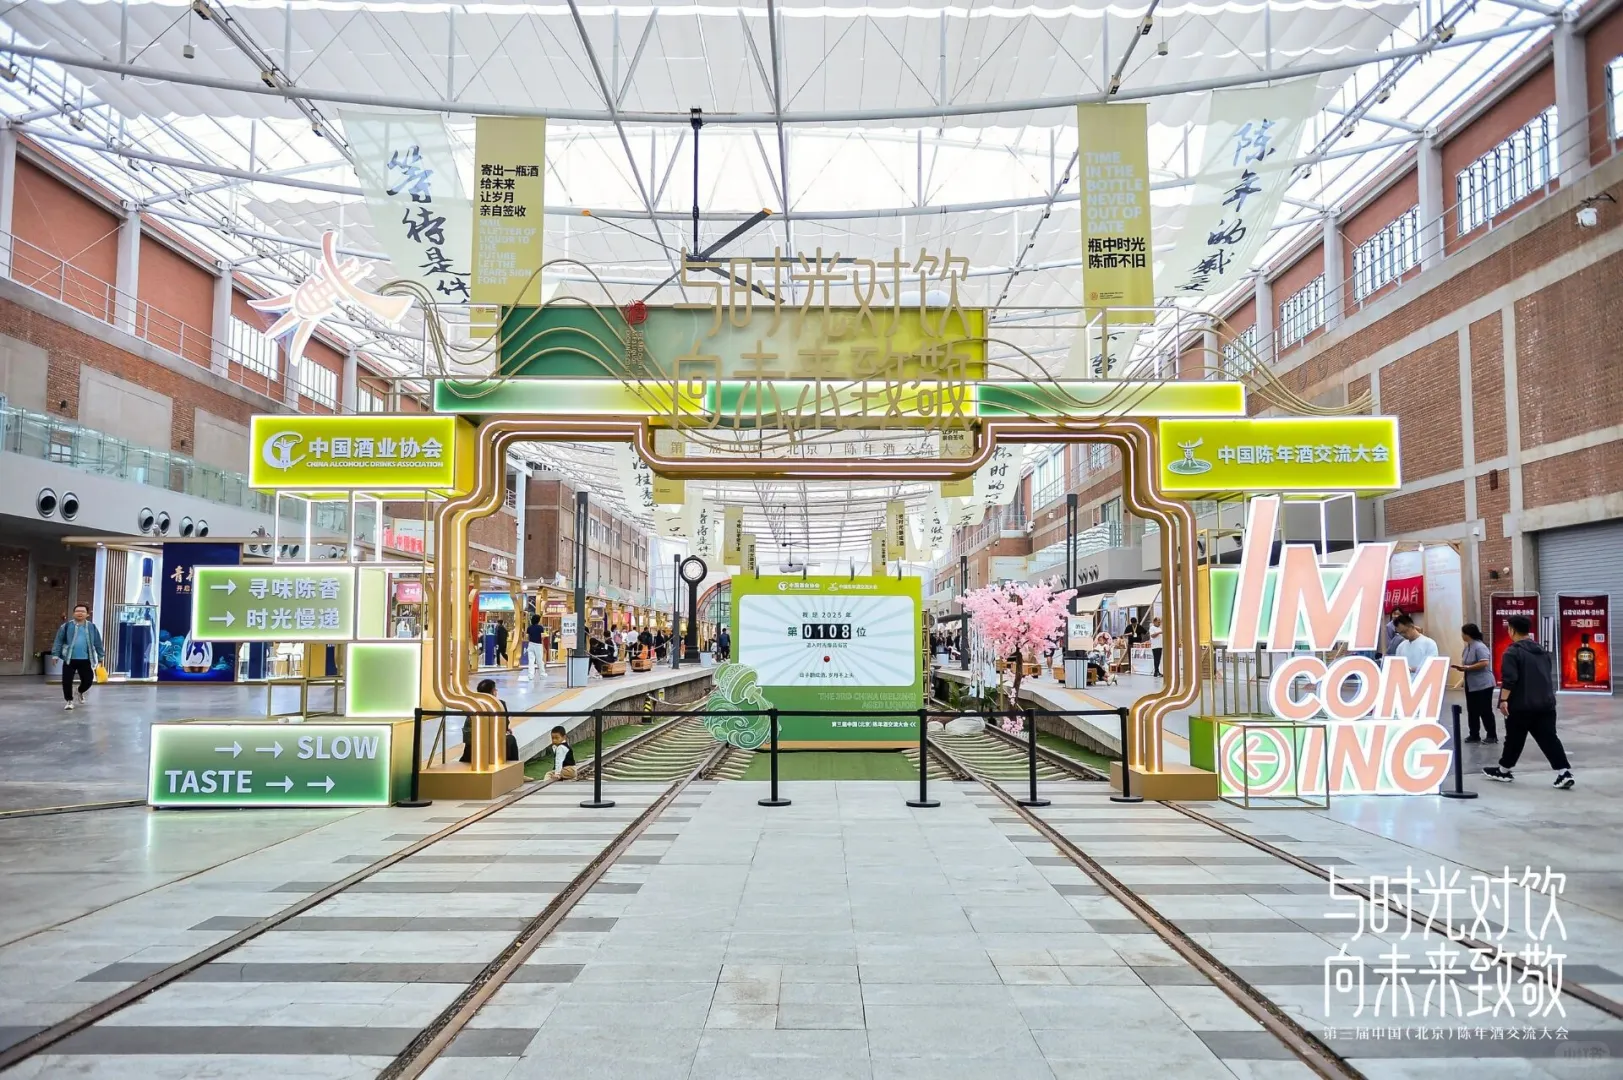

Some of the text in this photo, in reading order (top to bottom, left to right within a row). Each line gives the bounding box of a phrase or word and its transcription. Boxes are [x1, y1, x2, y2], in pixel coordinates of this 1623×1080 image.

[1086, 152, 1121, 164] TIME
[481, 164, 539, 177] 寄出一瓶酒
[1086, 165, 1133, 177] IN THE
[480, 178, 515, 189] 给未来
[1086, 179, 1143, 191] BOTTLE
[480, 191, 514, 203] 让岁月
[1087, 193, 1136, 205] NEVER
[480, 205, 526, 217] 亲自签收
[1087, 207, 1142, 219] OUT OF
[479, 219, 500, 227] MAIL
[1088, 221, 1125, 233] DATE
[487, 228, 522, 236] LETTER
[479, 236, 530, 244] LIQUOR TO
[1088, 237, 1145, 252] 瓶中时光
[478, 252, 516, 260] FUTURE
[1088, 253, 1146, 269] 陈而不旧
[498, 277, 508, 285] IT
[673, 247, 970, 338] 与时光对饮
[672, 339, 971, 430] 向未来致敬
[309, 437, 443, 458] 中国酒业协会
[1217, 443, 1389, 465] 中国陈年酒交流大会
[1229, 498, 1394, 651] IM
[249, 578, 341, 600] 寻味陈香
[247, 607, 340, 630] 时光慢递
[788, 627, 798, 637] 第
[804, 624, 850, 638] 0108
[856, 627, 867, 637] 位
[1270, 656, 1449, 720] COM
[297, 736, 379, 760] SLOW
[1300, 723, 1451, 796] ING
[165, 770, 253, 793] TASTE
